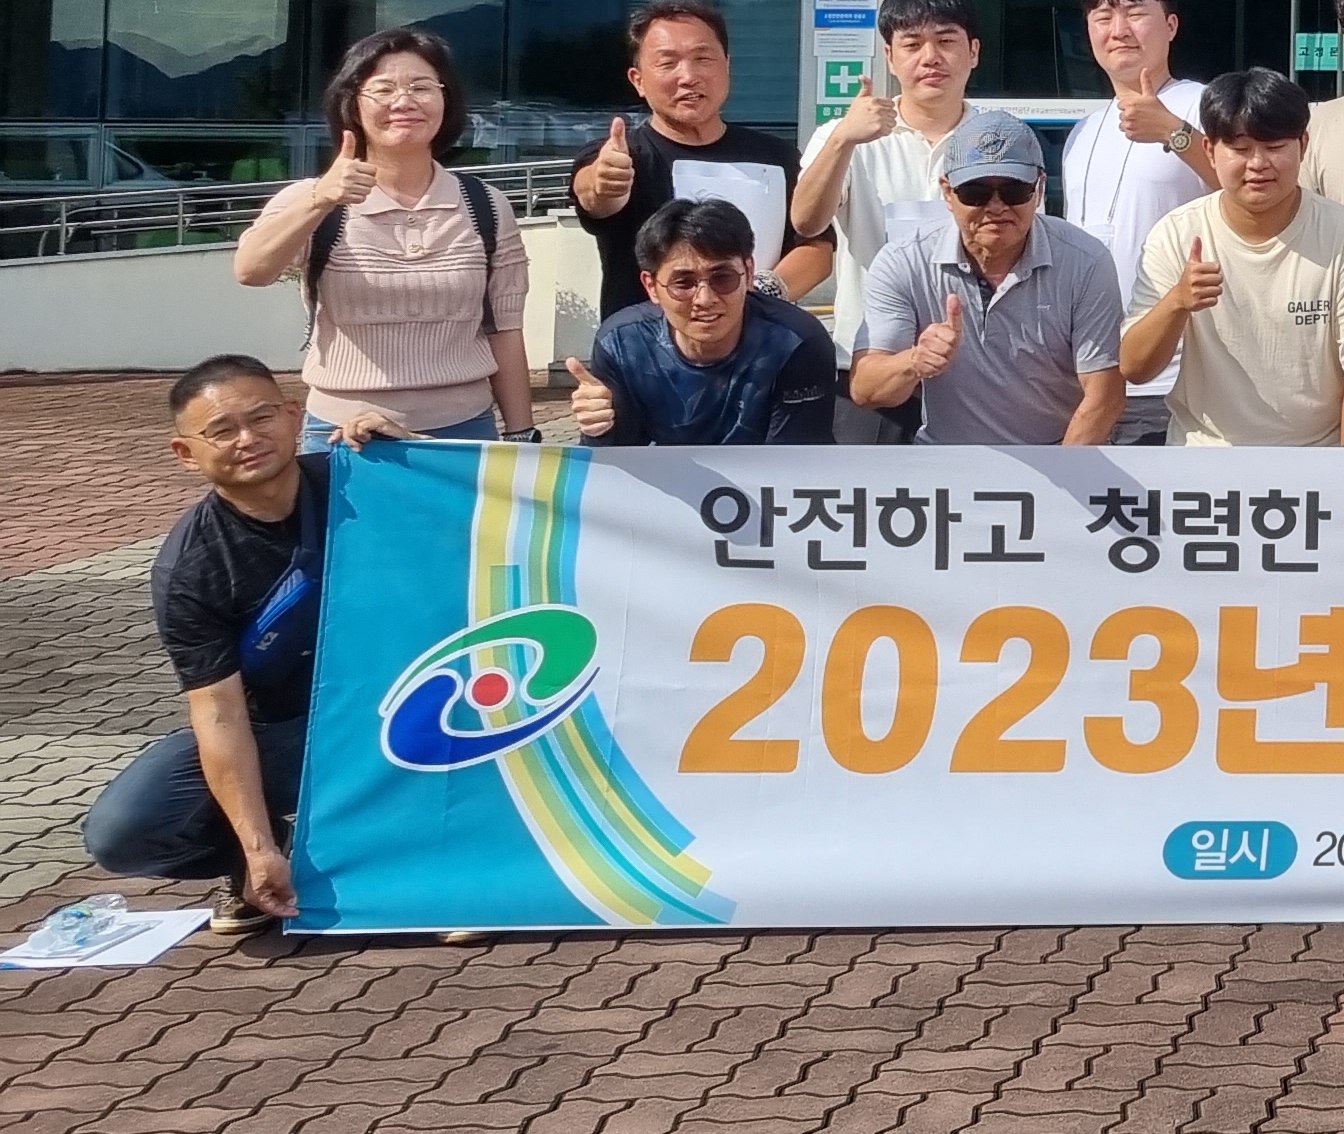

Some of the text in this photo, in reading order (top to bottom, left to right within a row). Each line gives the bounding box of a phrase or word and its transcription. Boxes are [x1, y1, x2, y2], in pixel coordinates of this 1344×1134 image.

[1287, 299, 1331, 314] GALLER
[698, 484, 1332, 574] 안전하고 청렴한
[1190, 827, 1271, 872] 일시
